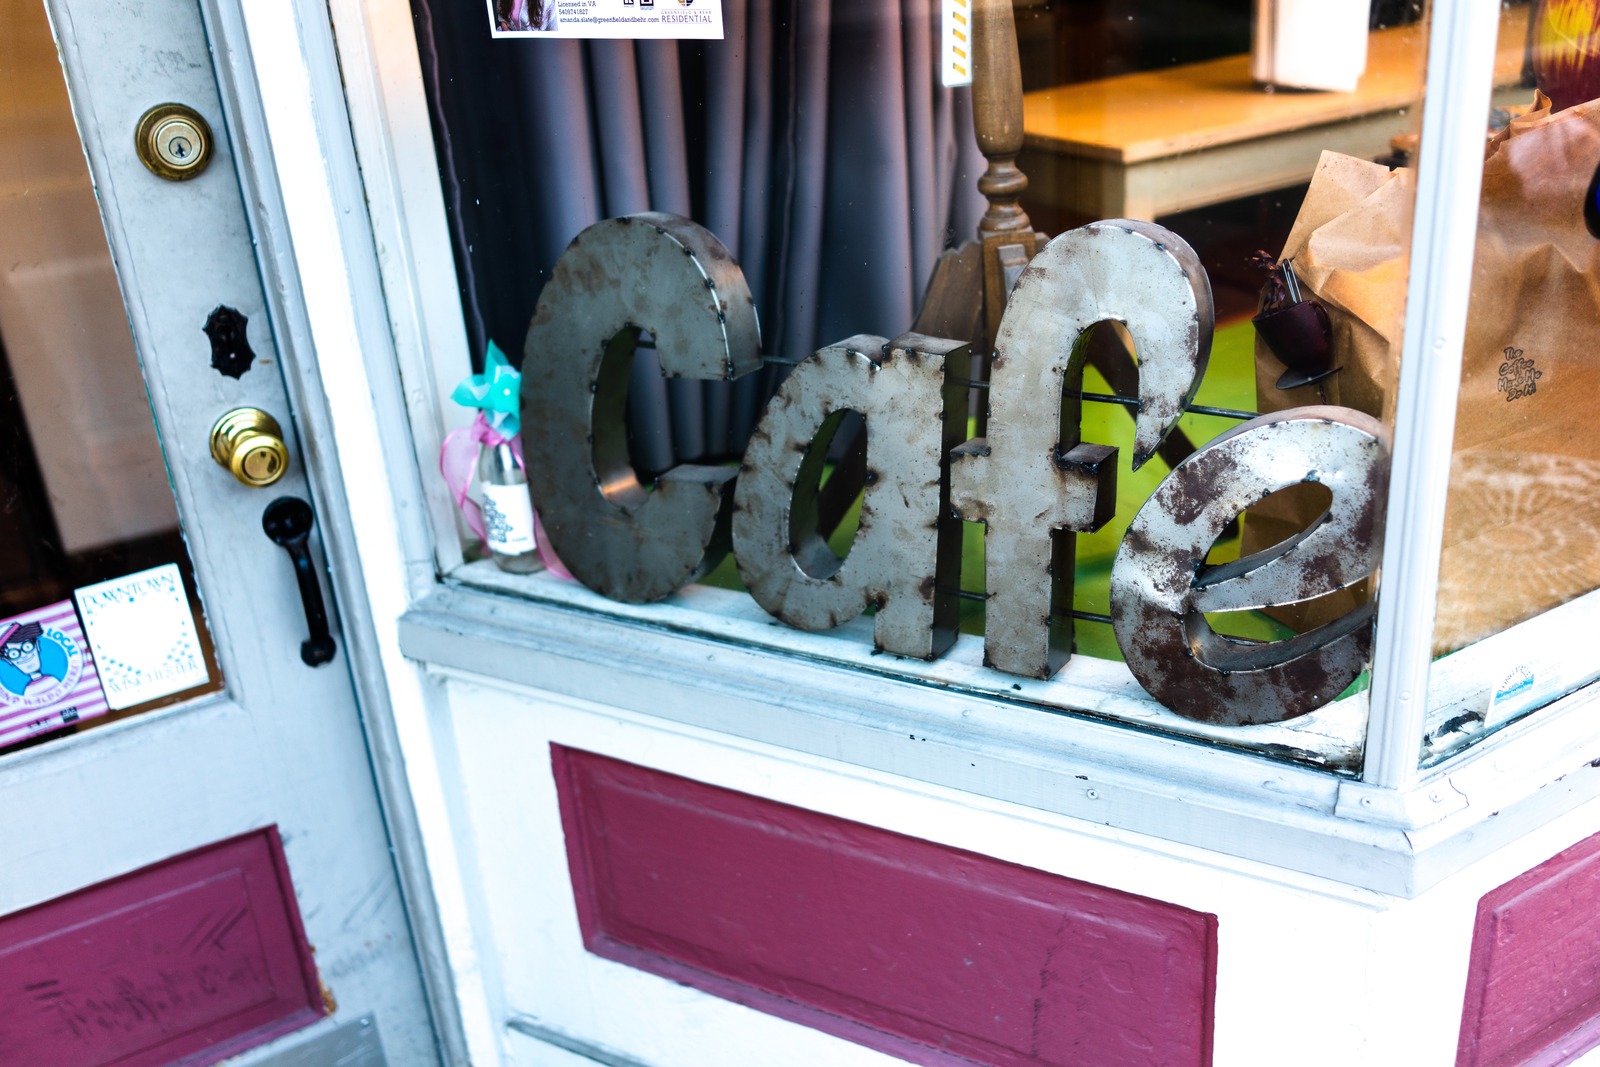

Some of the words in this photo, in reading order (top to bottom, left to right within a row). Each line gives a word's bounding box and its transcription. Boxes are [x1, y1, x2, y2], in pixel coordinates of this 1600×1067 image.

[661, 15, 713, 23] RESIDENTIAL
[1504, 346, 1524, 360] The
[1498, 358, 1535, 376] Coffee
[521, 211, 1388, 726] Cafe
[82, 573, 175, 608] DOWNTOWN
[46, 627, 79, 658] LOCAL
